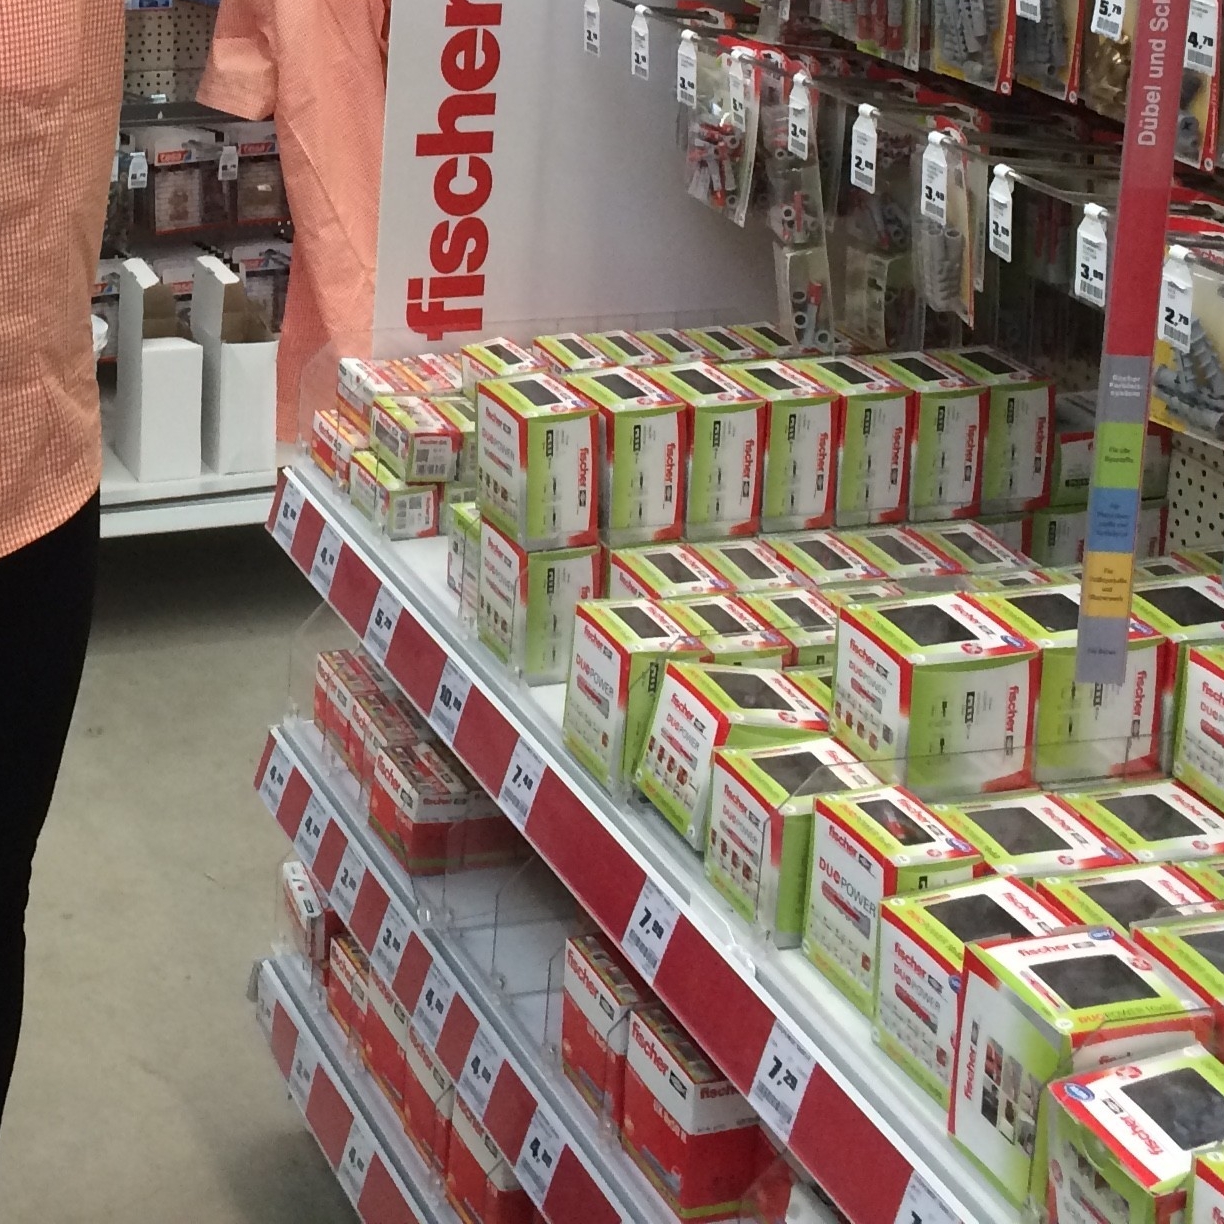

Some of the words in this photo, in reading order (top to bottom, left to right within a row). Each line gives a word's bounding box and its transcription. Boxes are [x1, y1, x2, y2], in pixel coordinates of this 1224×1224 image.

[1148, 38, 1167, 79] und
[1137, 85, 1162, 146] Dübel
[665, 442, 676, 484] fischer
[742, 438, 755, 480] fischer
[817, 431, 829, 473] fischer
[891, 426, 903, 468] fischer
[965, 423, 976, 465] fischer
[579, 447, 590, 489] fischer
[583, 624, 604, 652] fischer
[849, 638, 877, 671] fischer
[575, 652, 616, 699] DUOPOWER
[1132, 669, 1147, 717] fischer
[670, 692, 694, 723] fischer
[1005, 684, 1020, 733] fischer
[375, 754, 401, 791] fischer
[723, 783, 749, 817] fischer
[828, 825, 858, 858] fischer
[819, 855, 877, 919] DUOPOWER
[894, 941, 927, 979] fischer
[1017, 942, 1072, 957] fischer
[566, 948, 600, 1000] fischer
[893, 963, 941, 1011] DUOPOWER
[631, 1021, 670, 1076] fischer
[699, 1085, 741, 1101] fisch
[964, 1045, 977, 1101] fischer
[1119, 1113, 1165, 1156] fischer
